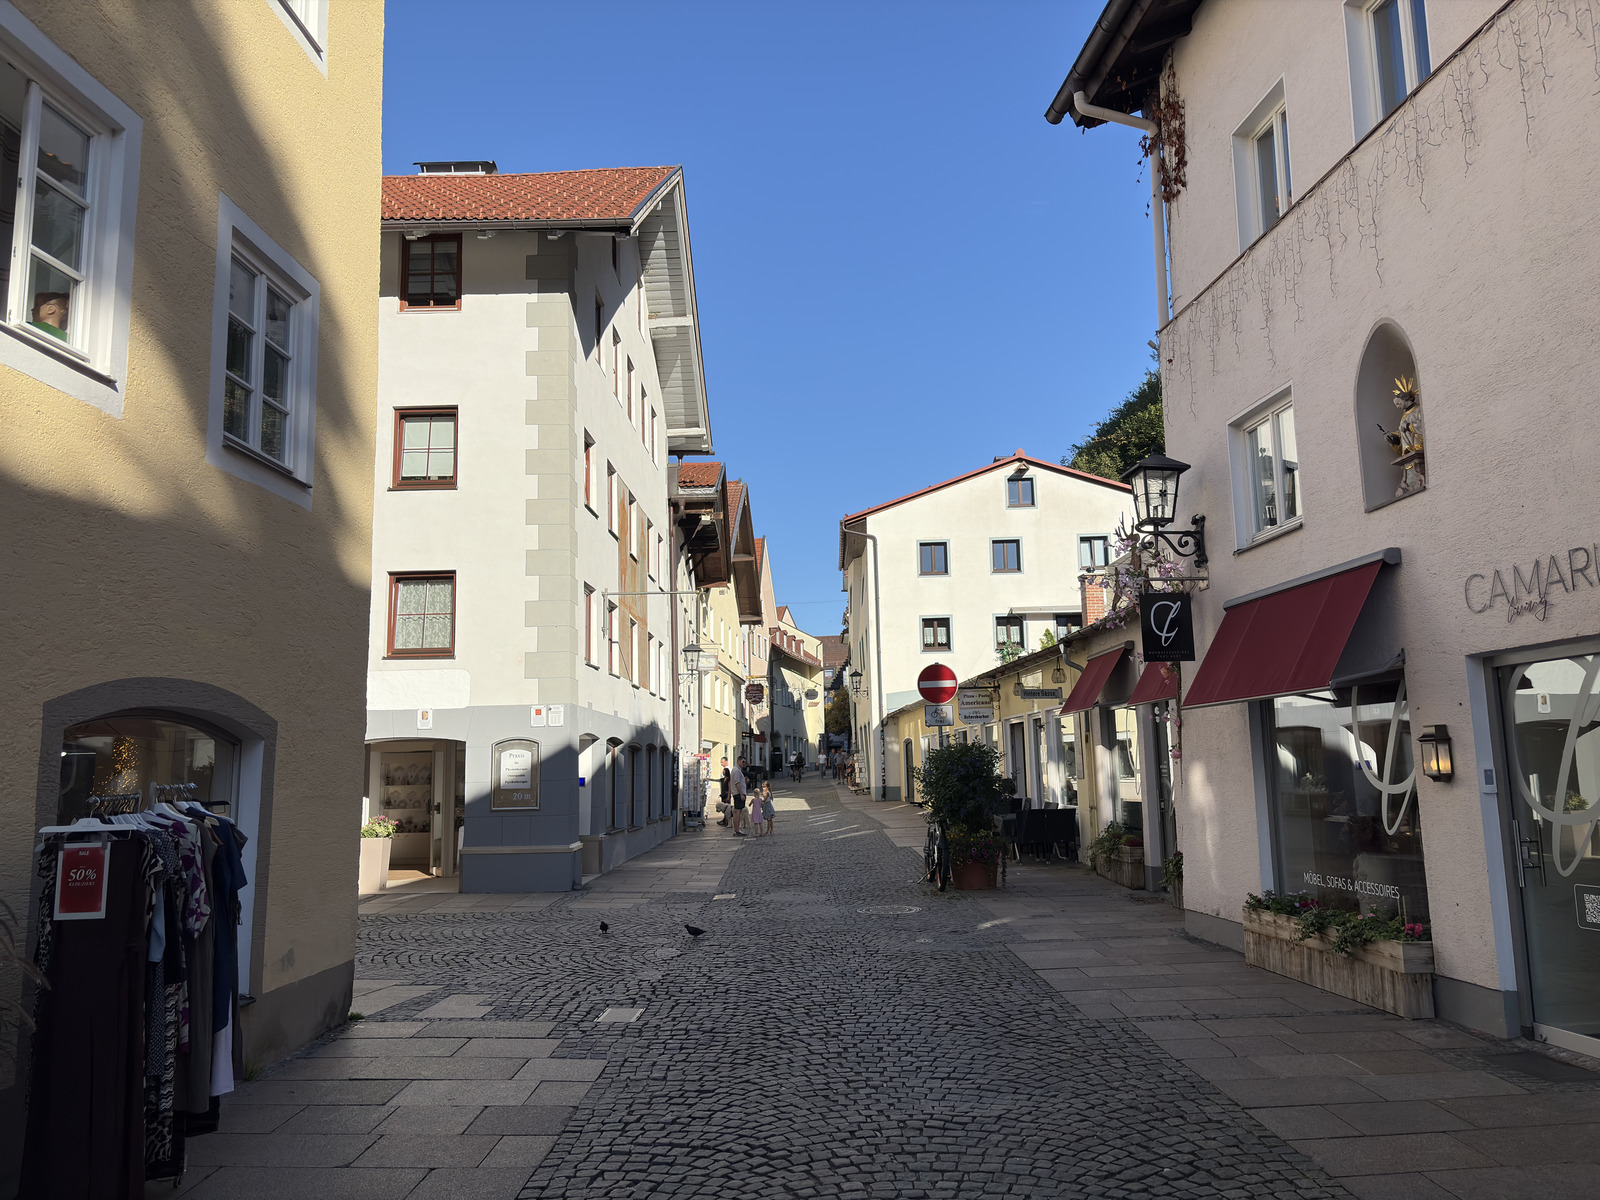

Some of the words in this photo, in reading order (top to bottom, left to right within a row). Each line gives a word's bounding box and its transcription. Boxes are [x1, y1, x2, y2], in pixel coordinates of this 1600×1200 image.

[1041, 689, 1056, 697] Gasse
[512, 792, 523, 800] 20
[68, 868, 97, 882] 50%
[1303, 870, 1326, 888] MÖBEL,
[1326, 875, 1347, 890] SOFAS
[1347, 879, 1353, 892] &
[1354, 880, 1400, 899] ACCESSOIRES
